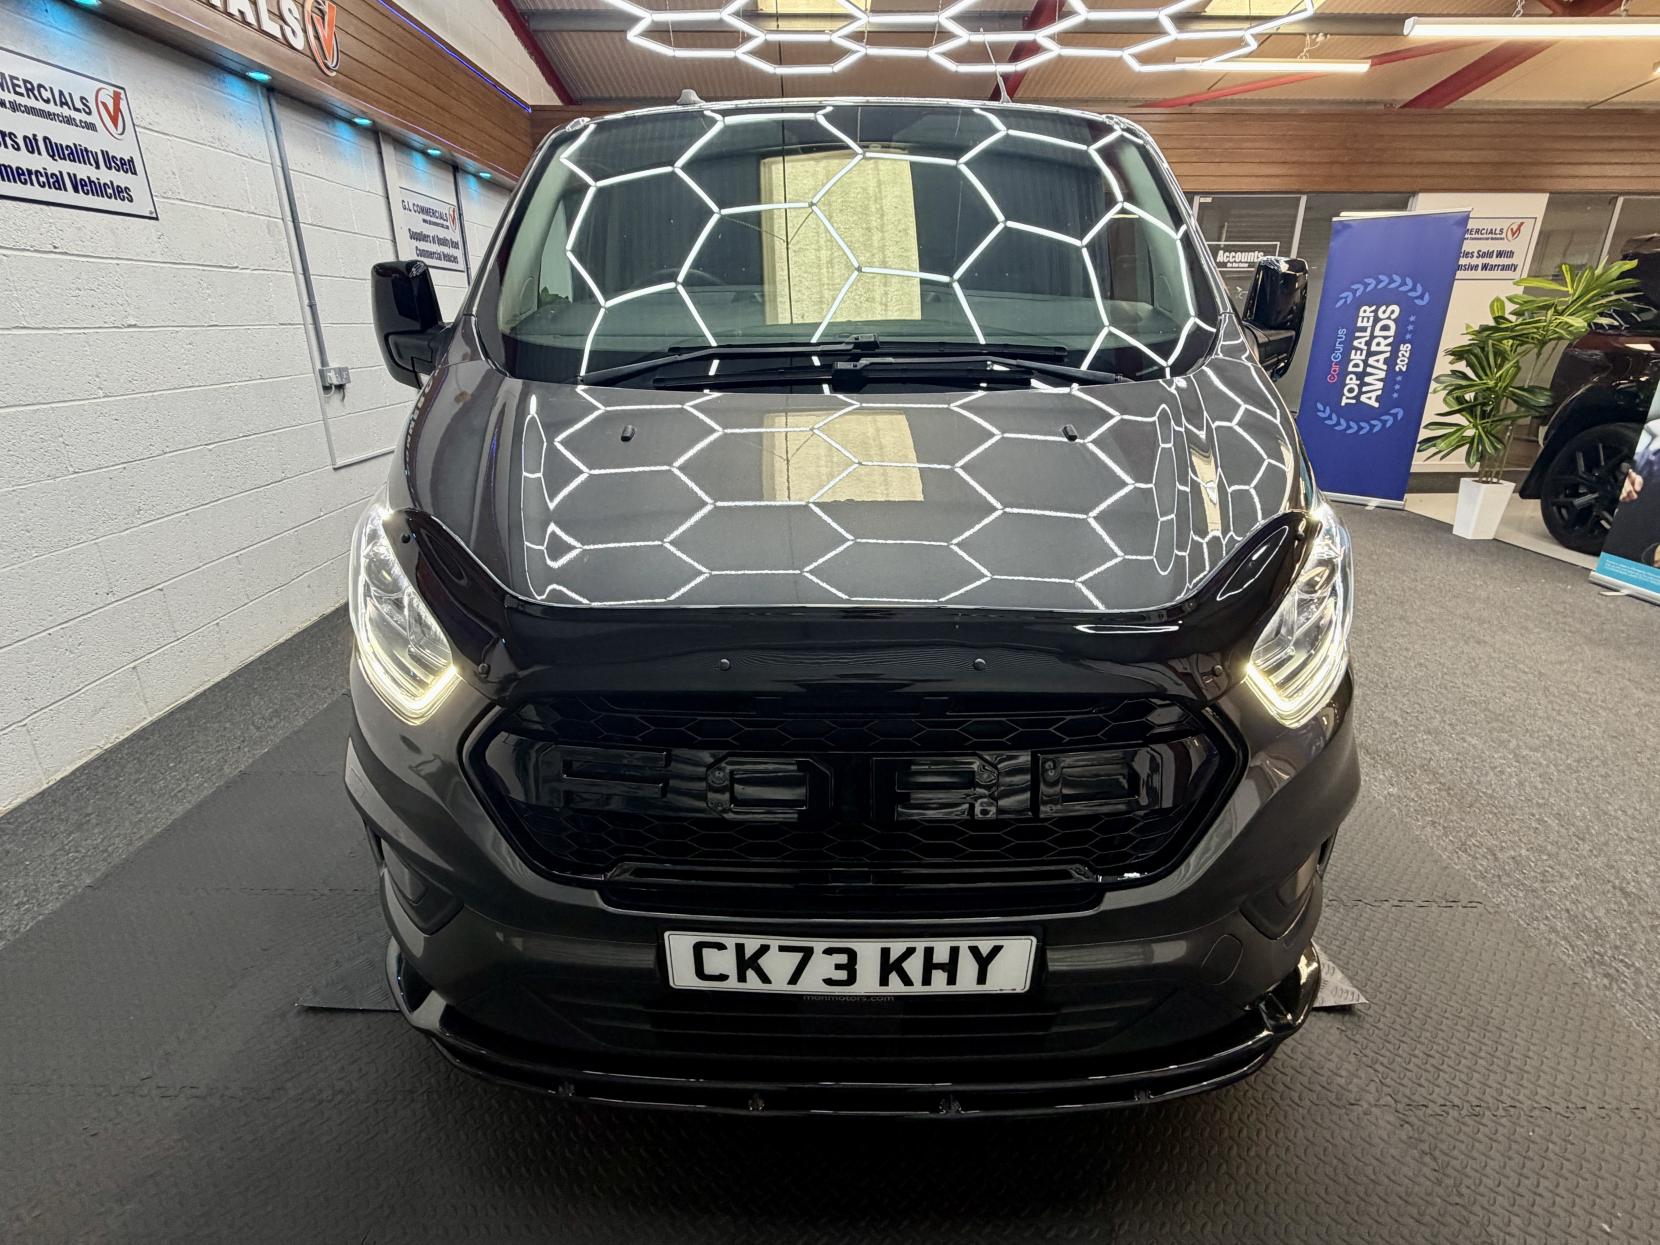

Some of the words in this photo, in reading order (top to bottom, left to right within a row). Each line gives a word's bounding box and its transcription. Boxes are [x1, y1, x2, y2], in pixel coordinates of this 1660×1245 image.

[209, 0, 304, 50] ALS
[0, 129, 21, 152] rs
[23, 133, 42, 157] of
[43, 135, 100, 170] Quality
[100, 149, 138, 176] Used
[67, 171, 134, 203] Vehicles
[413, 203, 448, 222] COMMERCIALS
[1216, 250, 1264, 263] Accounts
[1476, 250, 1495, 259] Sold
[1495, 250, 1515, 259] With
[1481, 262, 1518, 272] Warranty
[1348, 305, 1376, 372] DEALER
[1327, 328, 1347, 383] CarGurus
[1360, 304, 1400, 408] AWARDS
[1395, 343, 1411, 372] 2025
[1341, 374, 1360, 406] TOP
[692, 941, 858, 988] CK73
[878, 944, 1004, 988] KHY
